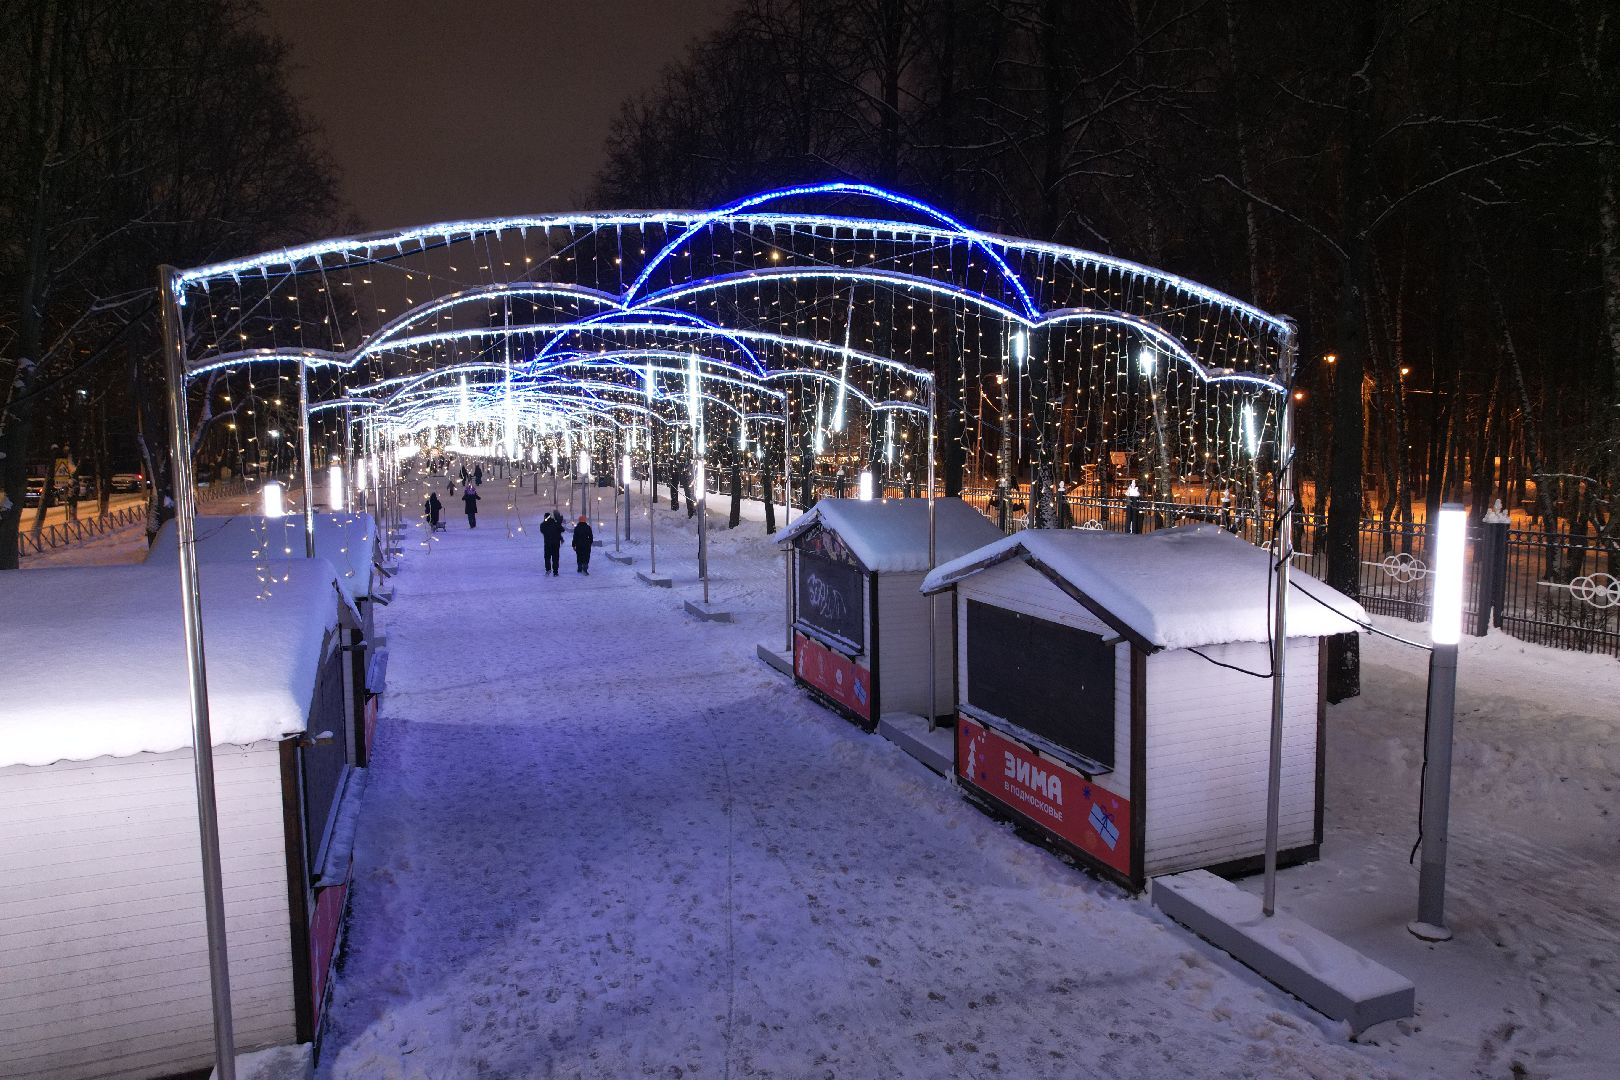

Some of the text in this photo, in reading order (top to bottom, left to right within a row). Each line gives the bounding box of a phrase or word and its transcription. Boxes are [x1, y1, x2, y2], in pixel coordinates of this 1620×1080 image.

[1004, 750, 1063, 806] ЗИМА
[1004, 781, 1063, 822] В ПОДМОСКОВЬЕ
